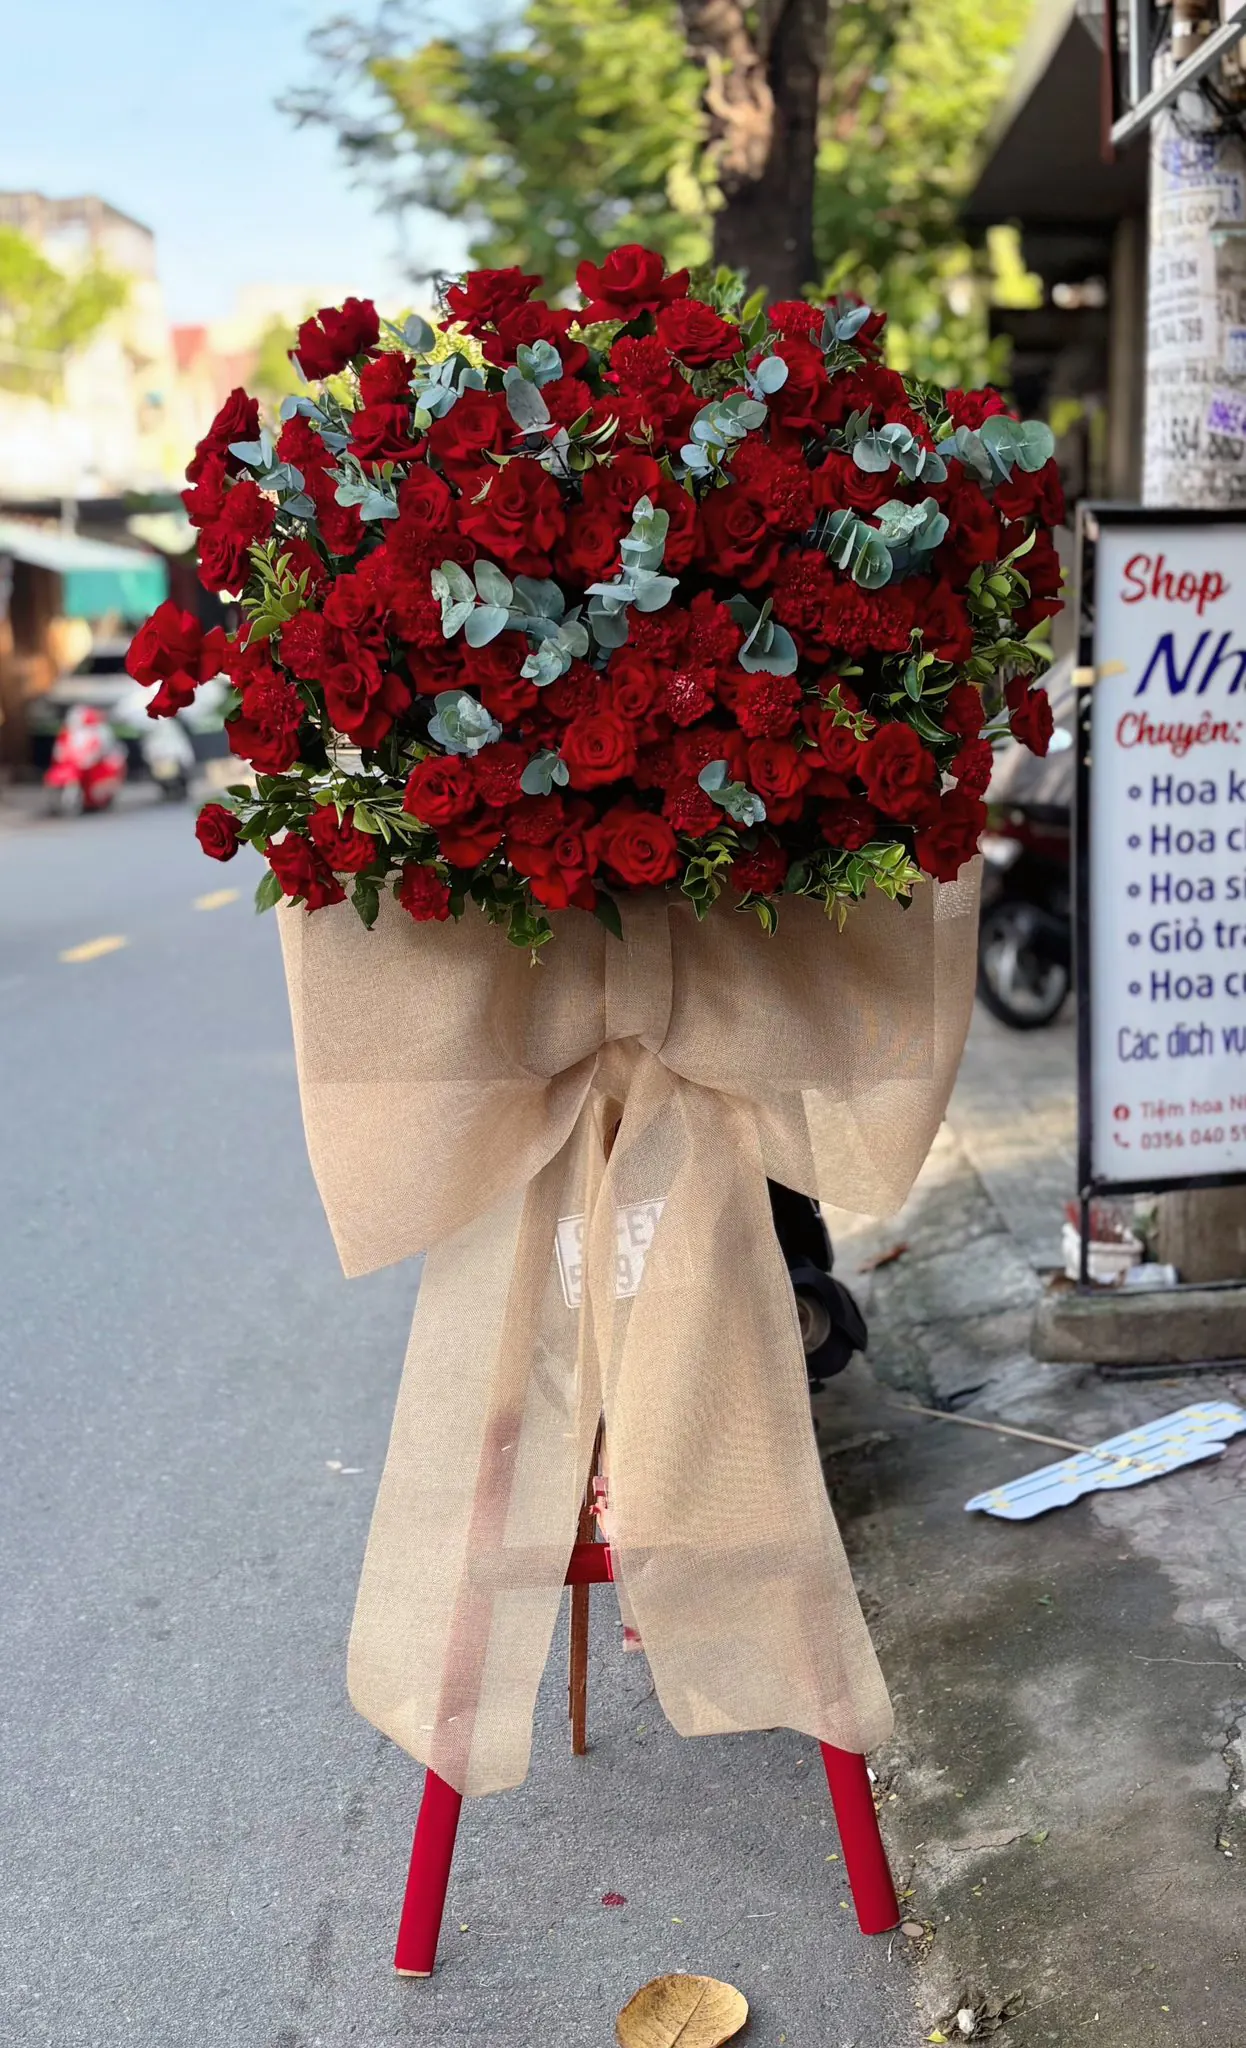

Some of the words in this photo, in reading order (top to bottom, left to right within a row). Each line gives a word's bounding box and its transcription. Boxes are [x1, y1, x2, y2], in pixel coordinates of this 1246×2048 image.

[1120, 553, 1231, 617] Shop
[1116, 711, 1242, 757] Chuyên:
[1151, 775, 1216, 806] Hoa
[1150, 824, 1215, 855] Hoa
[1227, 820, 1246, 852] c
[1150, 873, 1215, 903] Hoa
[1150, 917, 1203, 953] Giỏ
[1150, 970, 1214, 1002] Hoa
[1224, 971, 1246, 997] c
[1117, 1026, 1159, 1061] Các
[1190, 1098, 1223, 1114] hoa
[1141, 1131, 1184, 1150] 0356
[1190, 1127, 1224, 1145] 040
